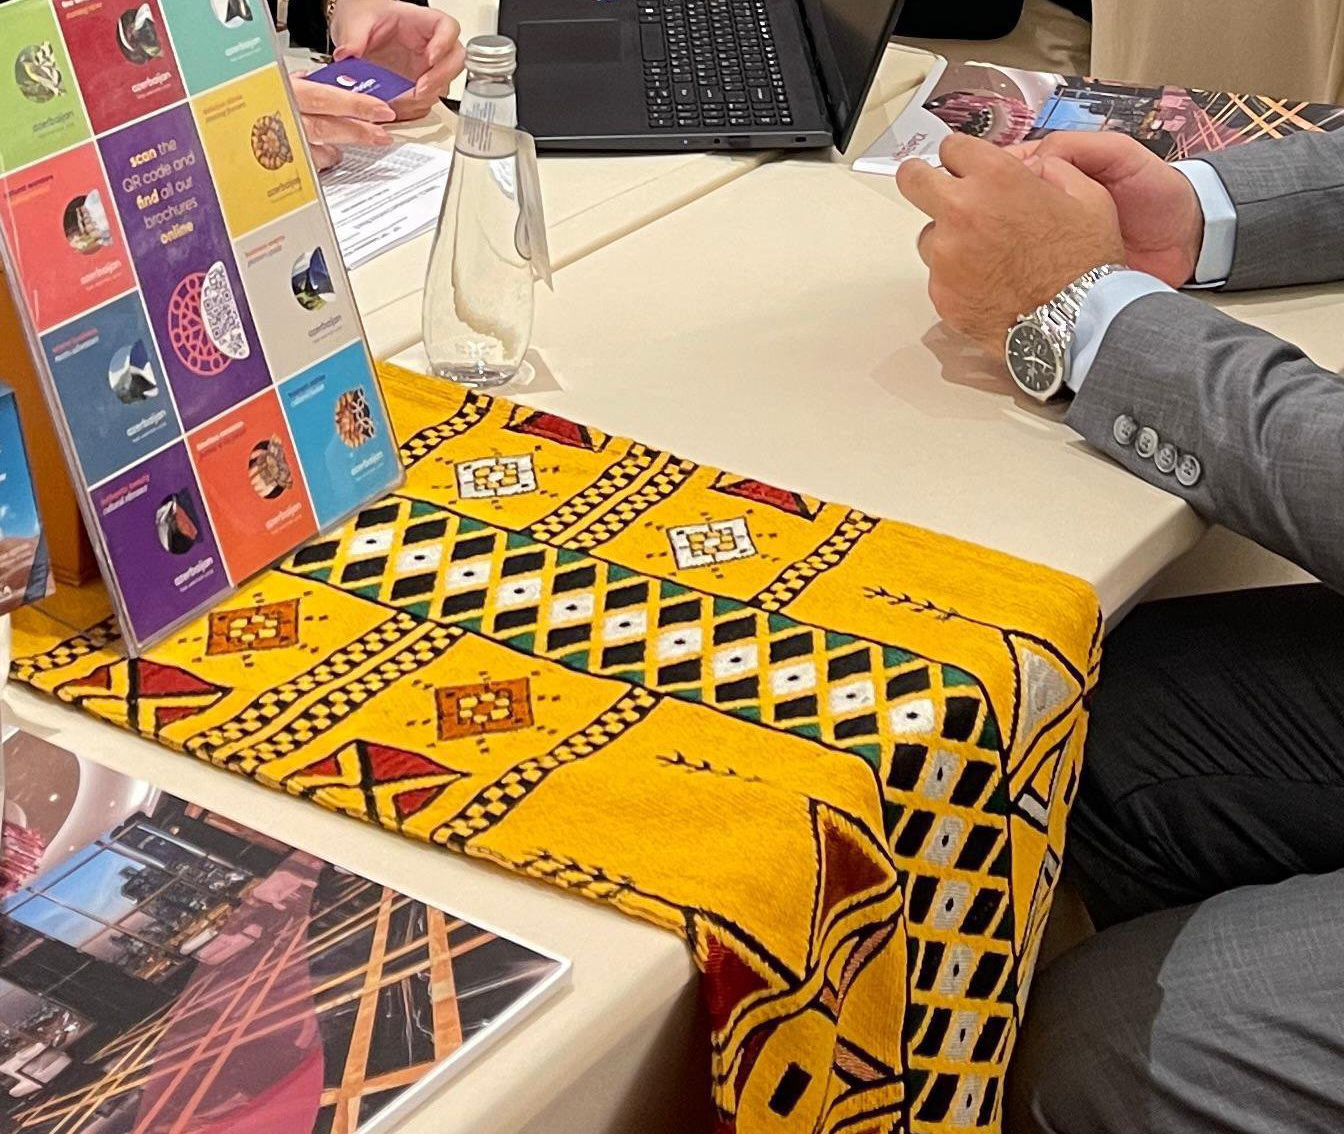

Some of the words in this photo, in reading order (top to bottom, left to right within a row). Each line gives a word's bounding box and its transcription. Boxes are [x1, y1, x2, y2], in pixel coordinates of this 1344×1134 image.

[130, 148, 157, 168] scan
[158, 139, 177, 155] the
[122, 175, 142, 192] QR
[143, 163, 172, 184] code
[173, 151, 195, 171] and
[137, 188, 159, 210] find
[161, 182, 174, 199] all
[175, 176, 193, 192] our
[144, 197, 198, 229] brochures
[161, 221, 194, 245] online
